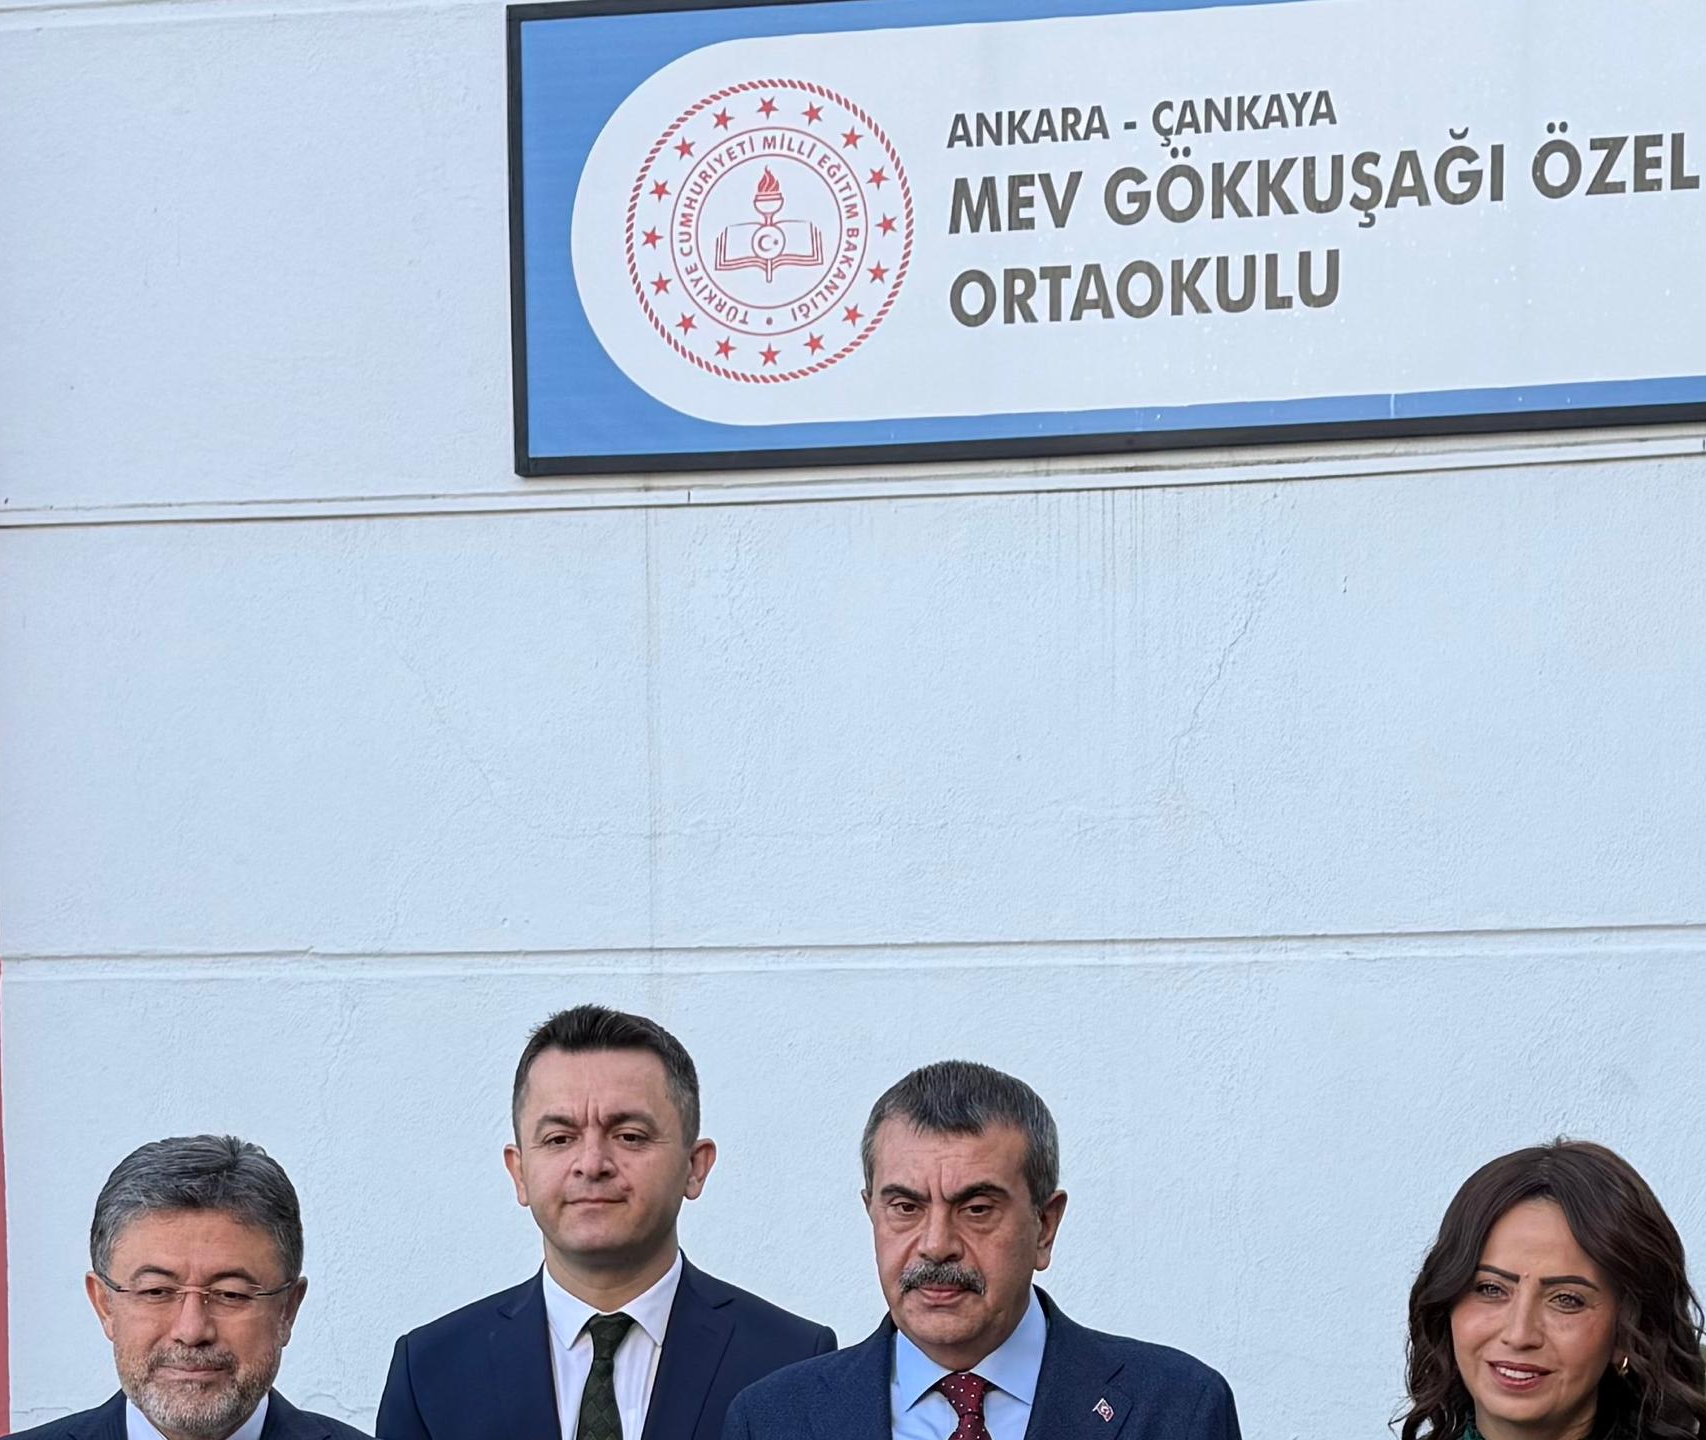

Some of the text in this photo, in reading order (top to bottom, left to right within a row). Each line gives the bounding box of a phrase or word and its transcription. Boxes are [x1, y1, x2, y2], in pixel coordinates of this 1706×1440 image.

[947, 105, 1110, 149] ANKARA
[1151, 90, 1337, 147] ÇANKAYA
[948, 171, 1083, 234] MEV
[1104, 127, 1504, 228] GÖKKUŞAĞI
[1532, 121, 1700, 199] ÖZEL
[678, 133, 860, 325] TÜRKİYE CUMHURİYETİ MİLLİ EĞİTİM BAKANLIĞI
[949, 249, 1340, 328] ORTAOKULU
